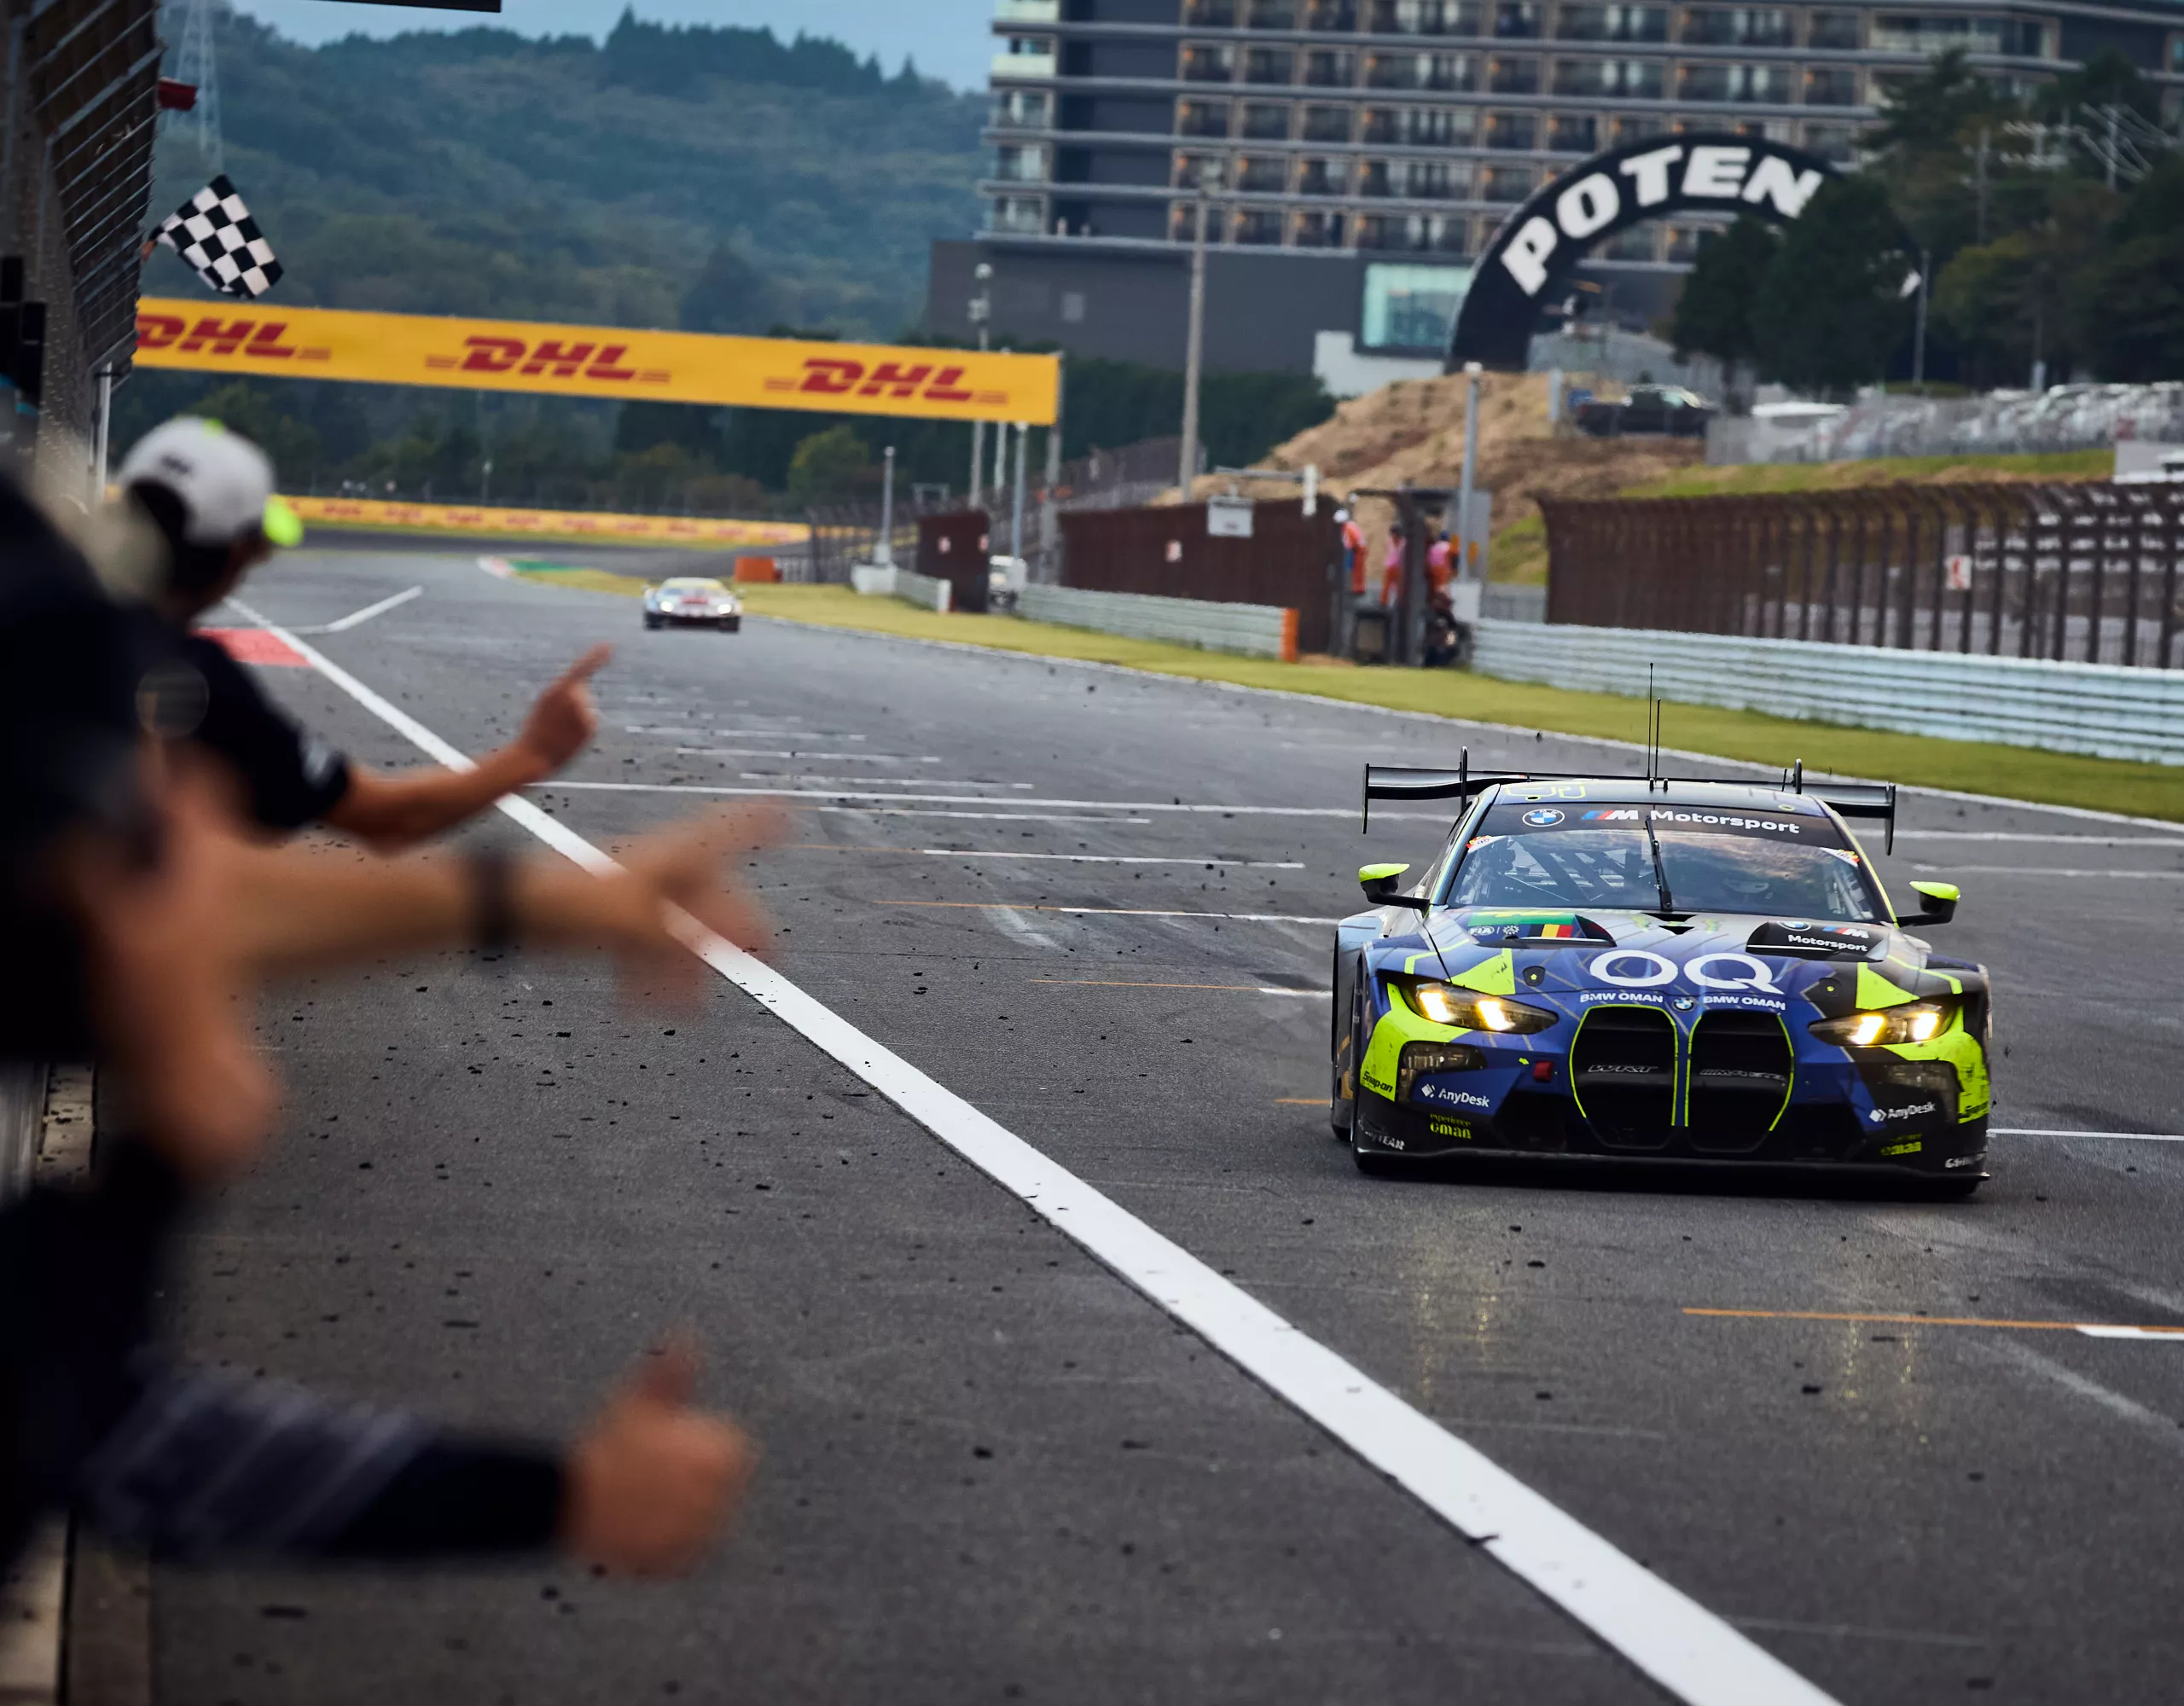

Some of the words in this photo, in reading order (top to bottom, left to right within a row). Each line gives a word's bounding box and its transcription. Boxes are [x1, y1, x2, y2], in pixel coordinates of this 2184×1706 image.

[135, 315, 296, 359] DHL
[461, 336, 636, 380] DHL
[799, 358, 973, 402] DHL
[1649, 809, 1800, 834] Motorsport
[1787, 934, 1868, 952] Motorsport
[1589, 949, 1784, 995] OQ
[1579, 993, 1616, 1003] BMW
[1618, 992, 1664, 1003] OMAN
[1703, 995, 1739, 1005] BMW
[1740, 996, 1786, 1011] OMAN
[1438, 1088, 1490, 1108] AnyDesk
